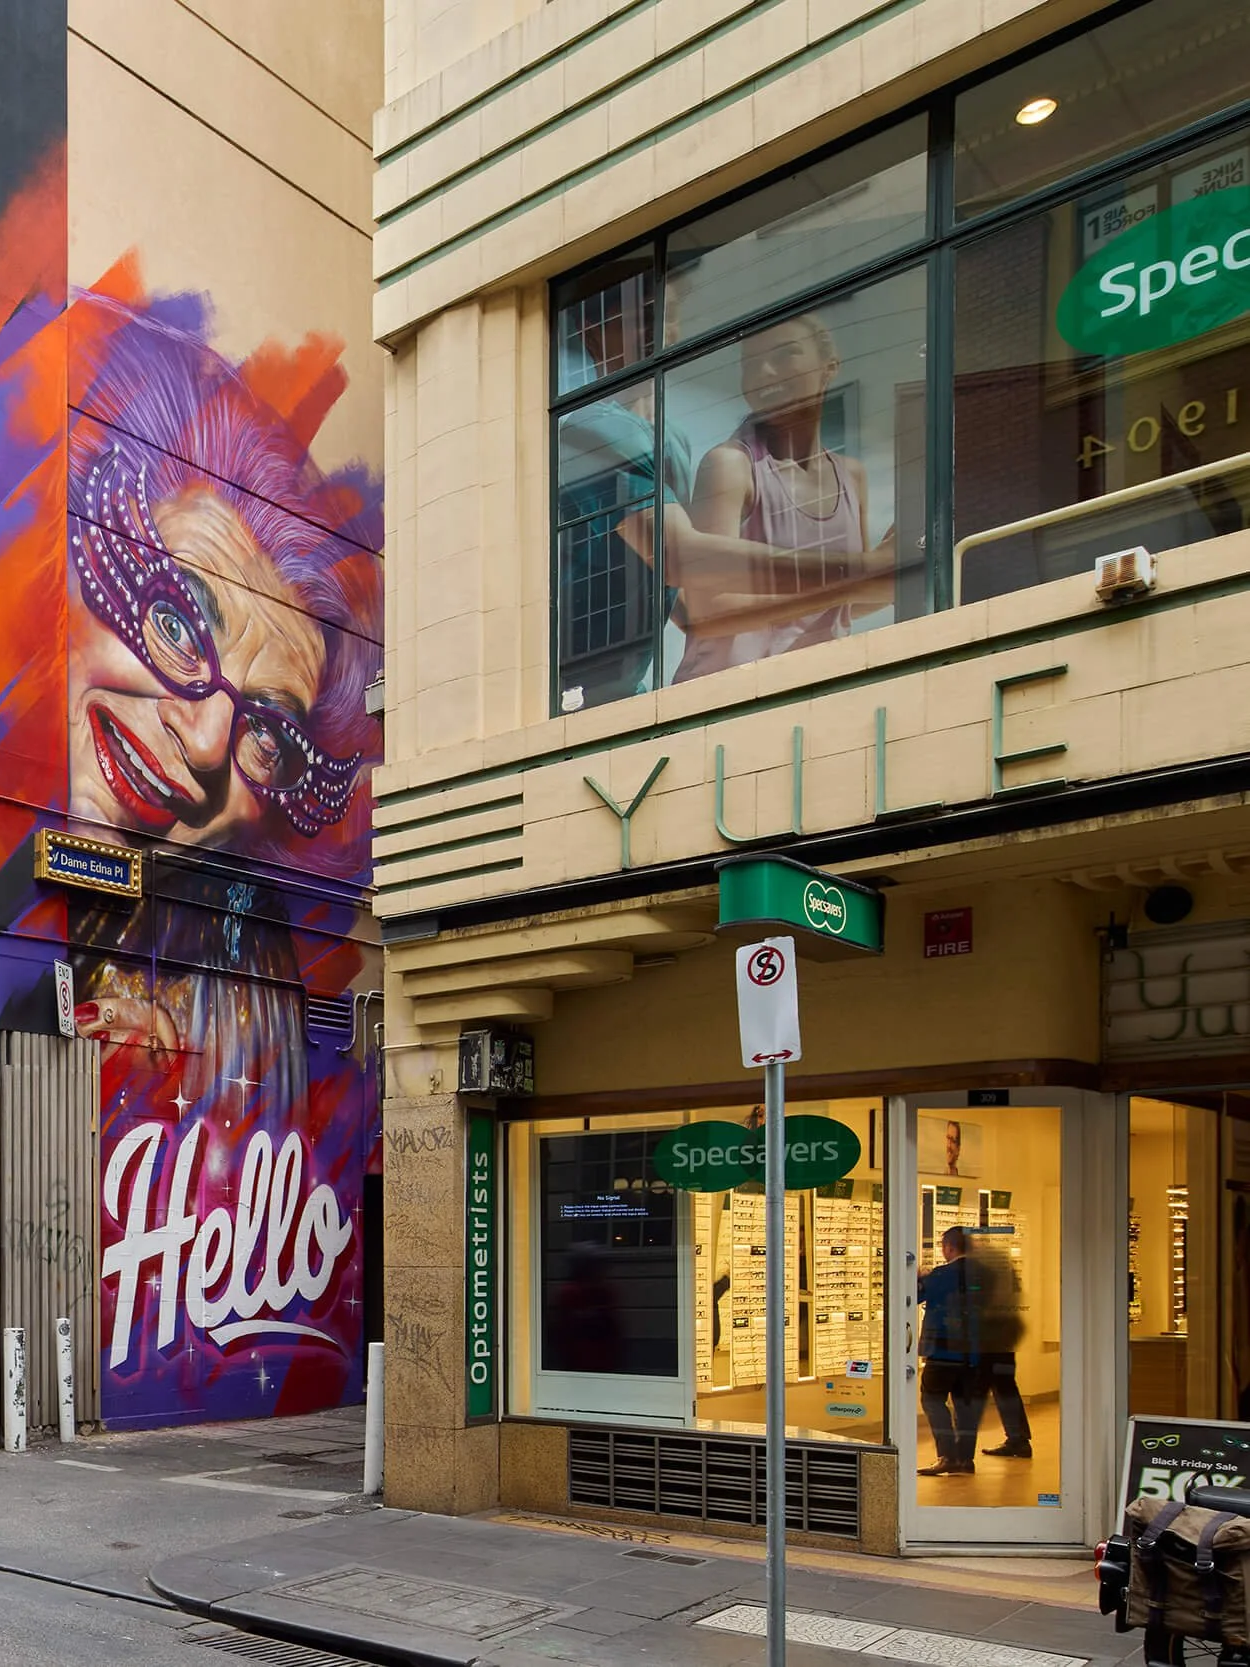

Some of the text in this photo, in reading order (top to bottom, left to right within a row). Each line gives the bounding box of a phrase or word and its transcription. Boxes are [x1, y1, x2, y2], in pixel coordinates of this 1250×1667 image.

[1100, 228, 1250, 318] Spec
[583, 663, 1069, 870] YULE
[60, 852, 124, 879] Dame Edna Pl
[808, 893, 842, 918] Specsavers
[926, 940, 971, 957] FIRE
[58, 965, 70, 980] END
[671, 1140, 840, 1174] Specsaers
[101, 1120, 352, 1371] Hello
[469, 1150, 492, 1386] Optometrists
[1151, 1456, 1239, 1472] Black Friday Sale
